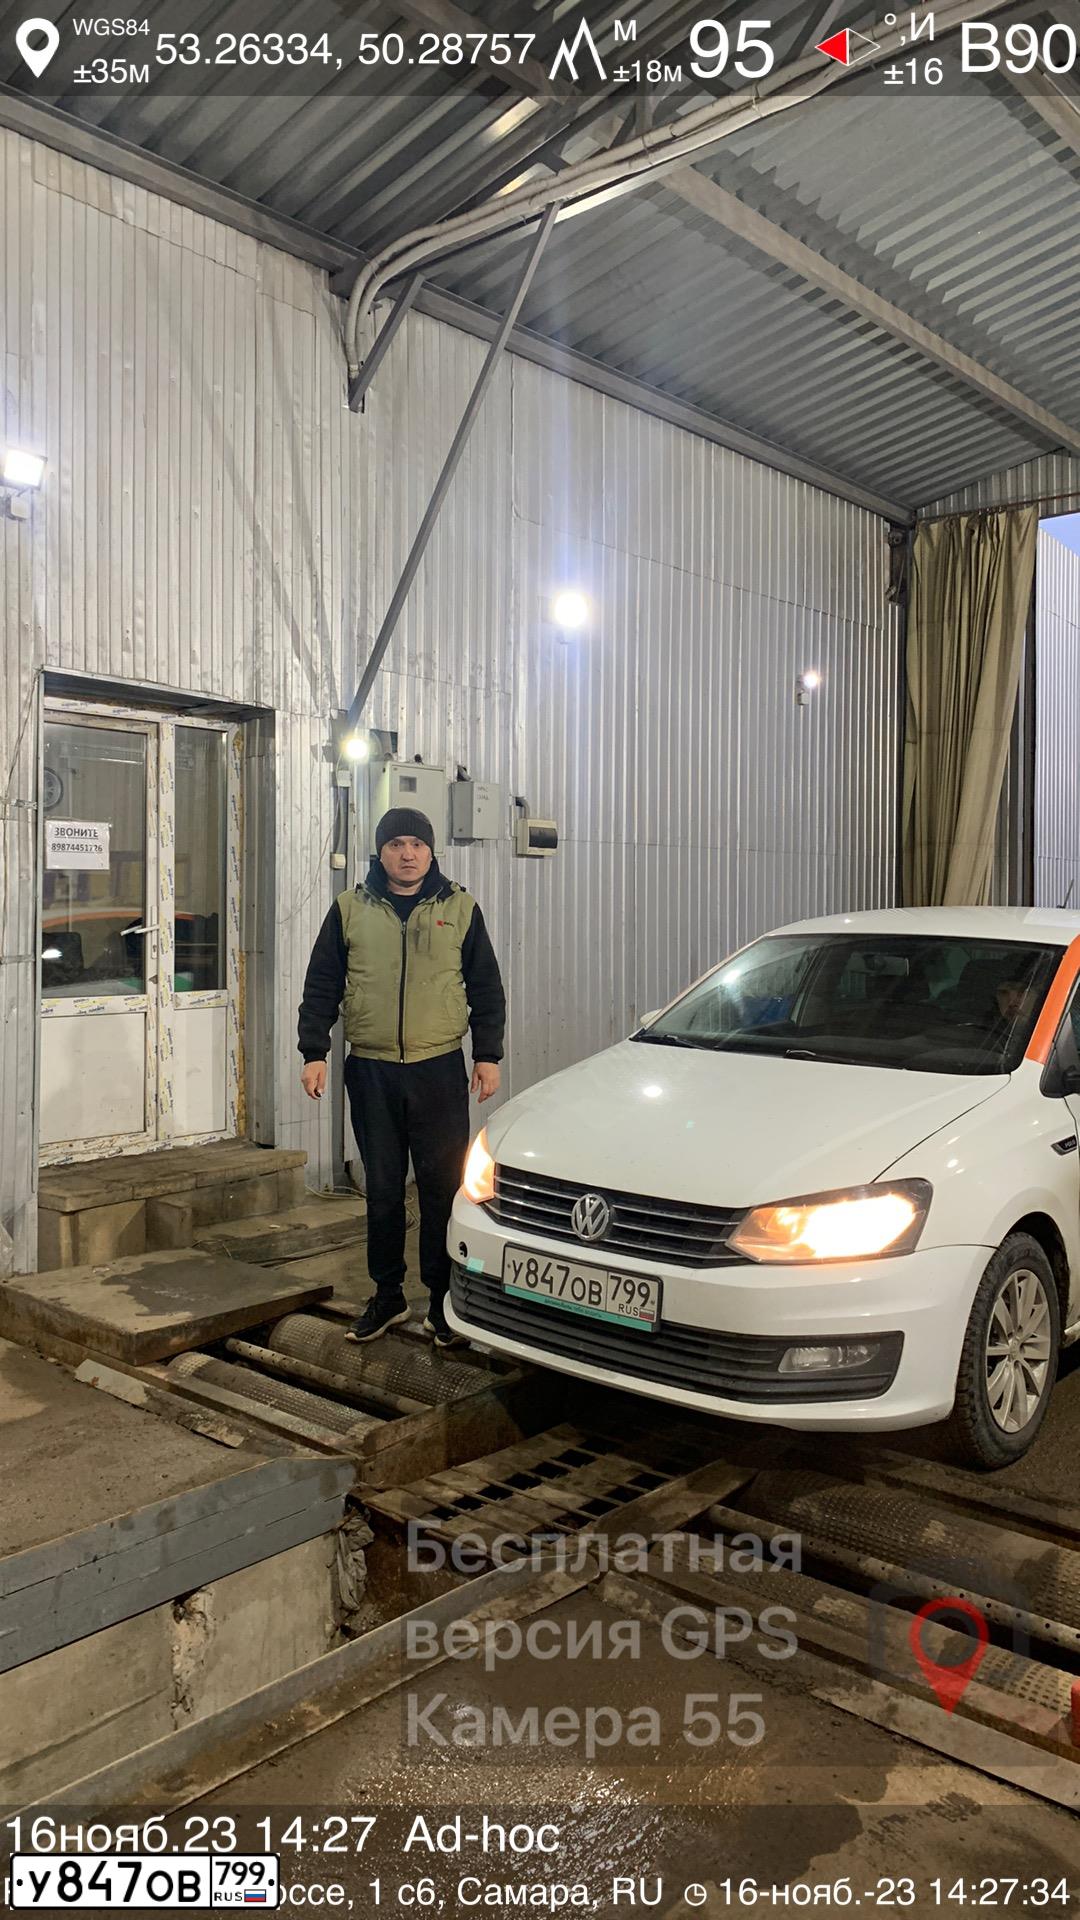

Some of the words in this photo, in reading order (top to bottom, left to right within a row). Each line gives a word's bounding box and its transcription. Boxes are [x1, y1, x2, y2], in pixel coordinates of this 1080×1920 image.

[54, 827, 99, 838] ЗВОНИТЕ
[511, 1257, 603, 1306] У847ОВ
[609, 1275, 651, 1308] 799
[618, 1303, 639, 1317] RUS
